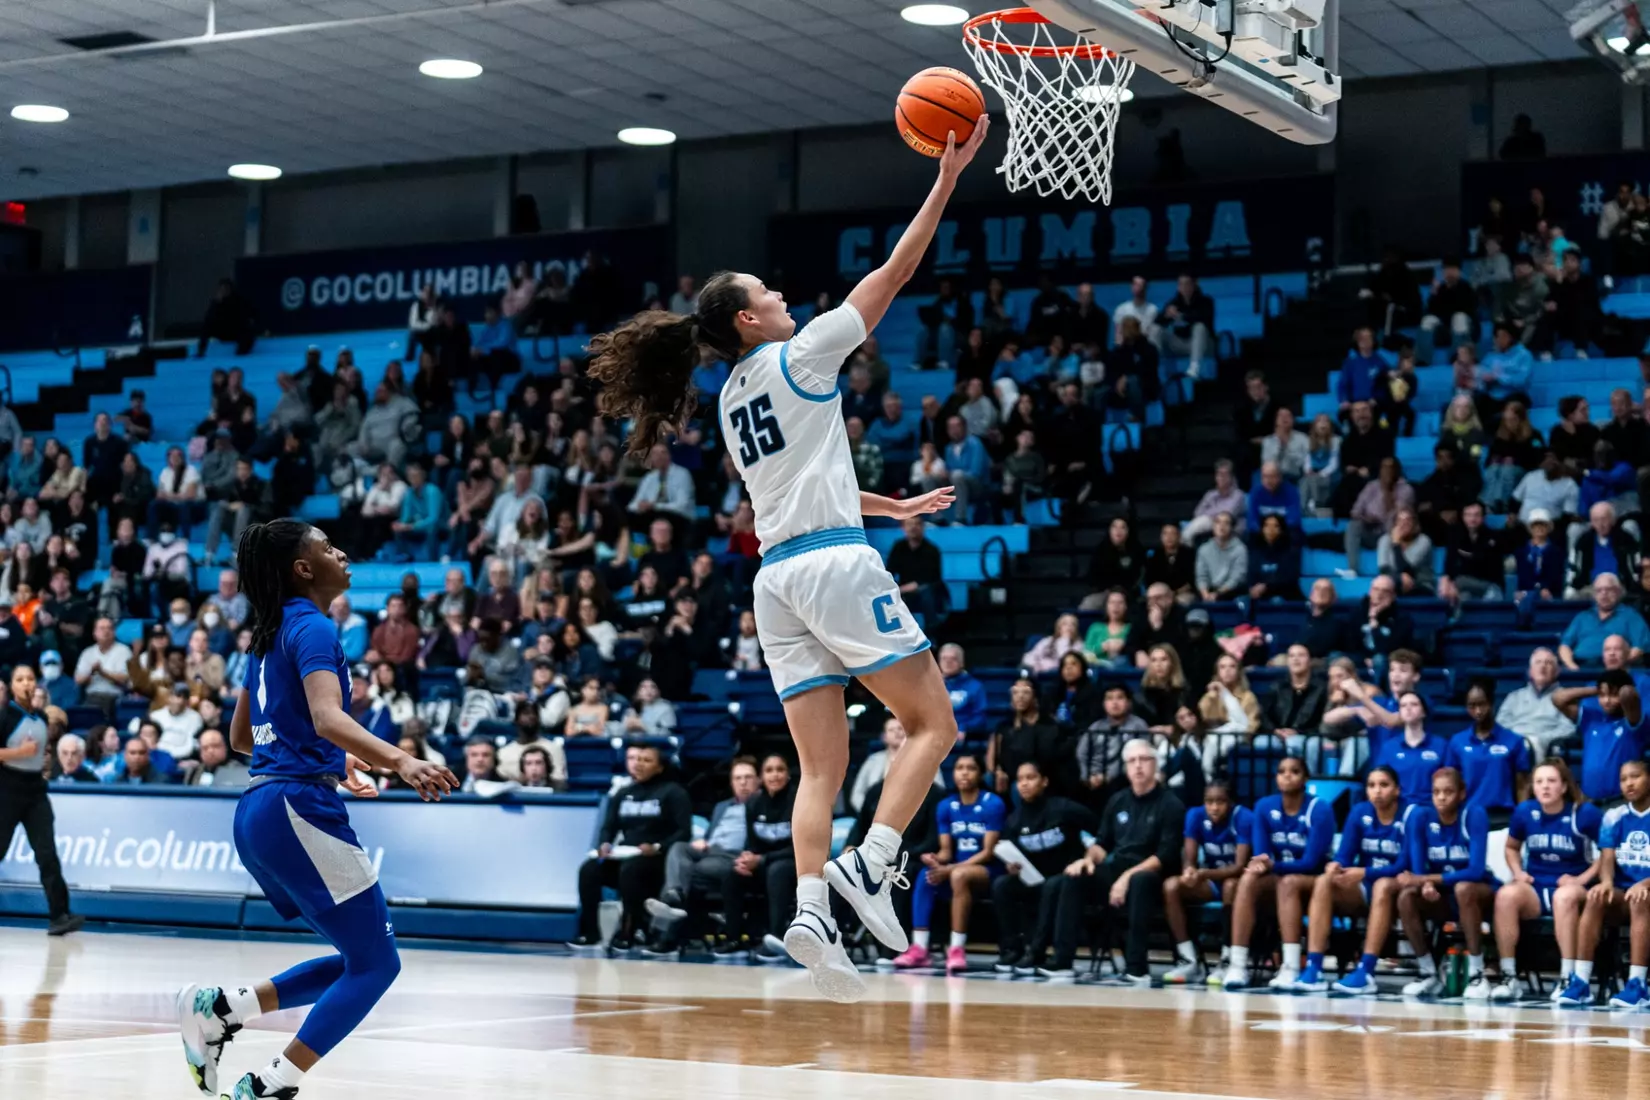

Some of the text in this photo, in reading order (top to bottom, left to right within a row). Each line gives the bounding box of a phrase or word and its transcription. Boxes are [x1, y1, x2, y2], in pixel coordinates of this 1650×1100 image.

[729, 393, 786, 469] 35
[872, 594, 903, 634] C
[257, 655, 267, 715] 1
